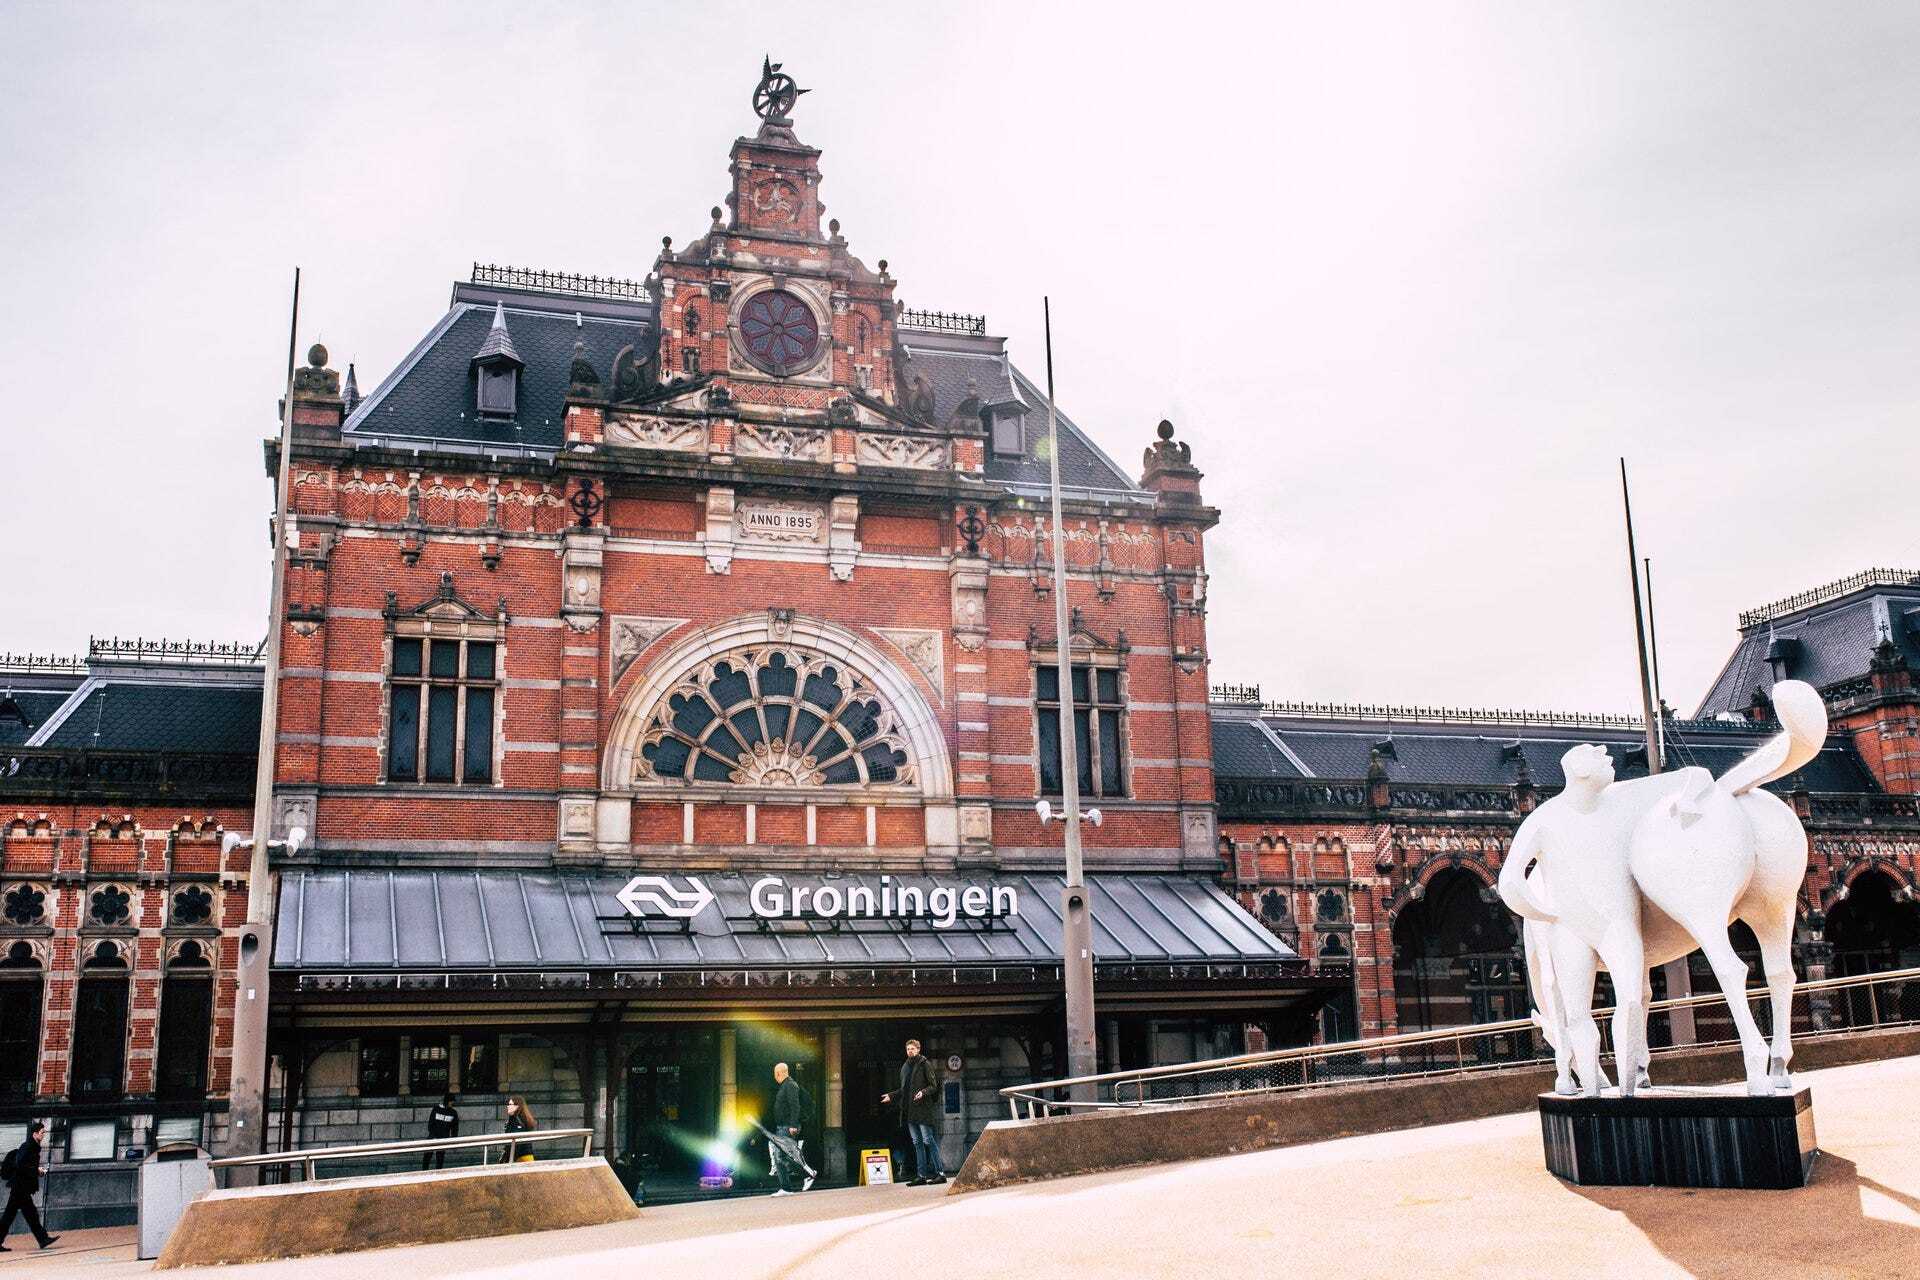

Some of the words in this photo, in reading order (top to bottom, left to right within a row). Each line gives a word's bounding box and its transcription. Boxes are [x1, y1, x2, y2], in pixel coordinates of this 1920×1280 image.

[750, 514, 780, 526] ANNO
[785, 516, 812, 528] 1895
[750, 876, 1018, 928] Groningen
